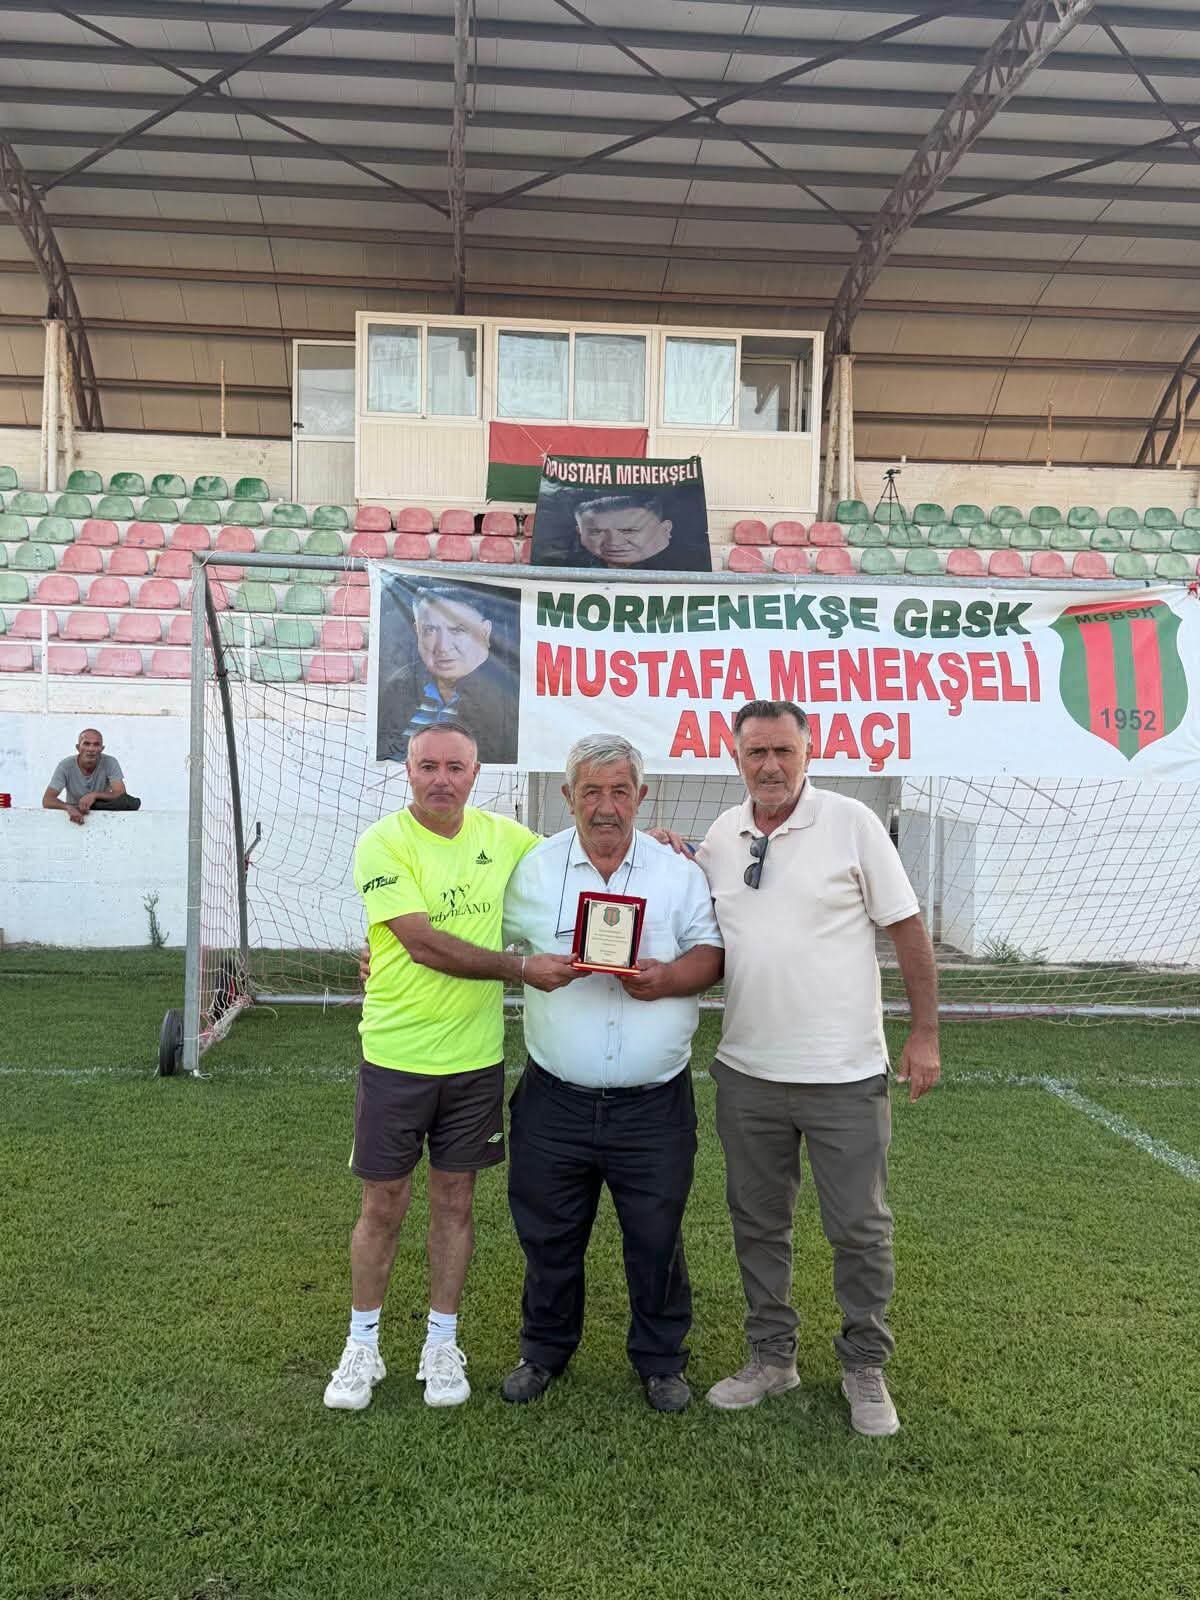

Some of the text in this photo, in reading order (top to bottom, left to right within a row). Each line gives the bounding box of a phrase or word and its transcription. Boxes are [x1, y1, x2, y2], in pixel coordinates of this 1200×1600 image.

[545, 458, 698, 485] MUSTAFA MENEKŞELİ
[537, 592, 1032, 638] MORMENEKŞE GBSK
[1074, 607, 1156, 624] MGBSK
[536, 641, 1041, 716] MUSTAFA MENEKŞELİ
[1100, 707, 1157, 731] 1952
